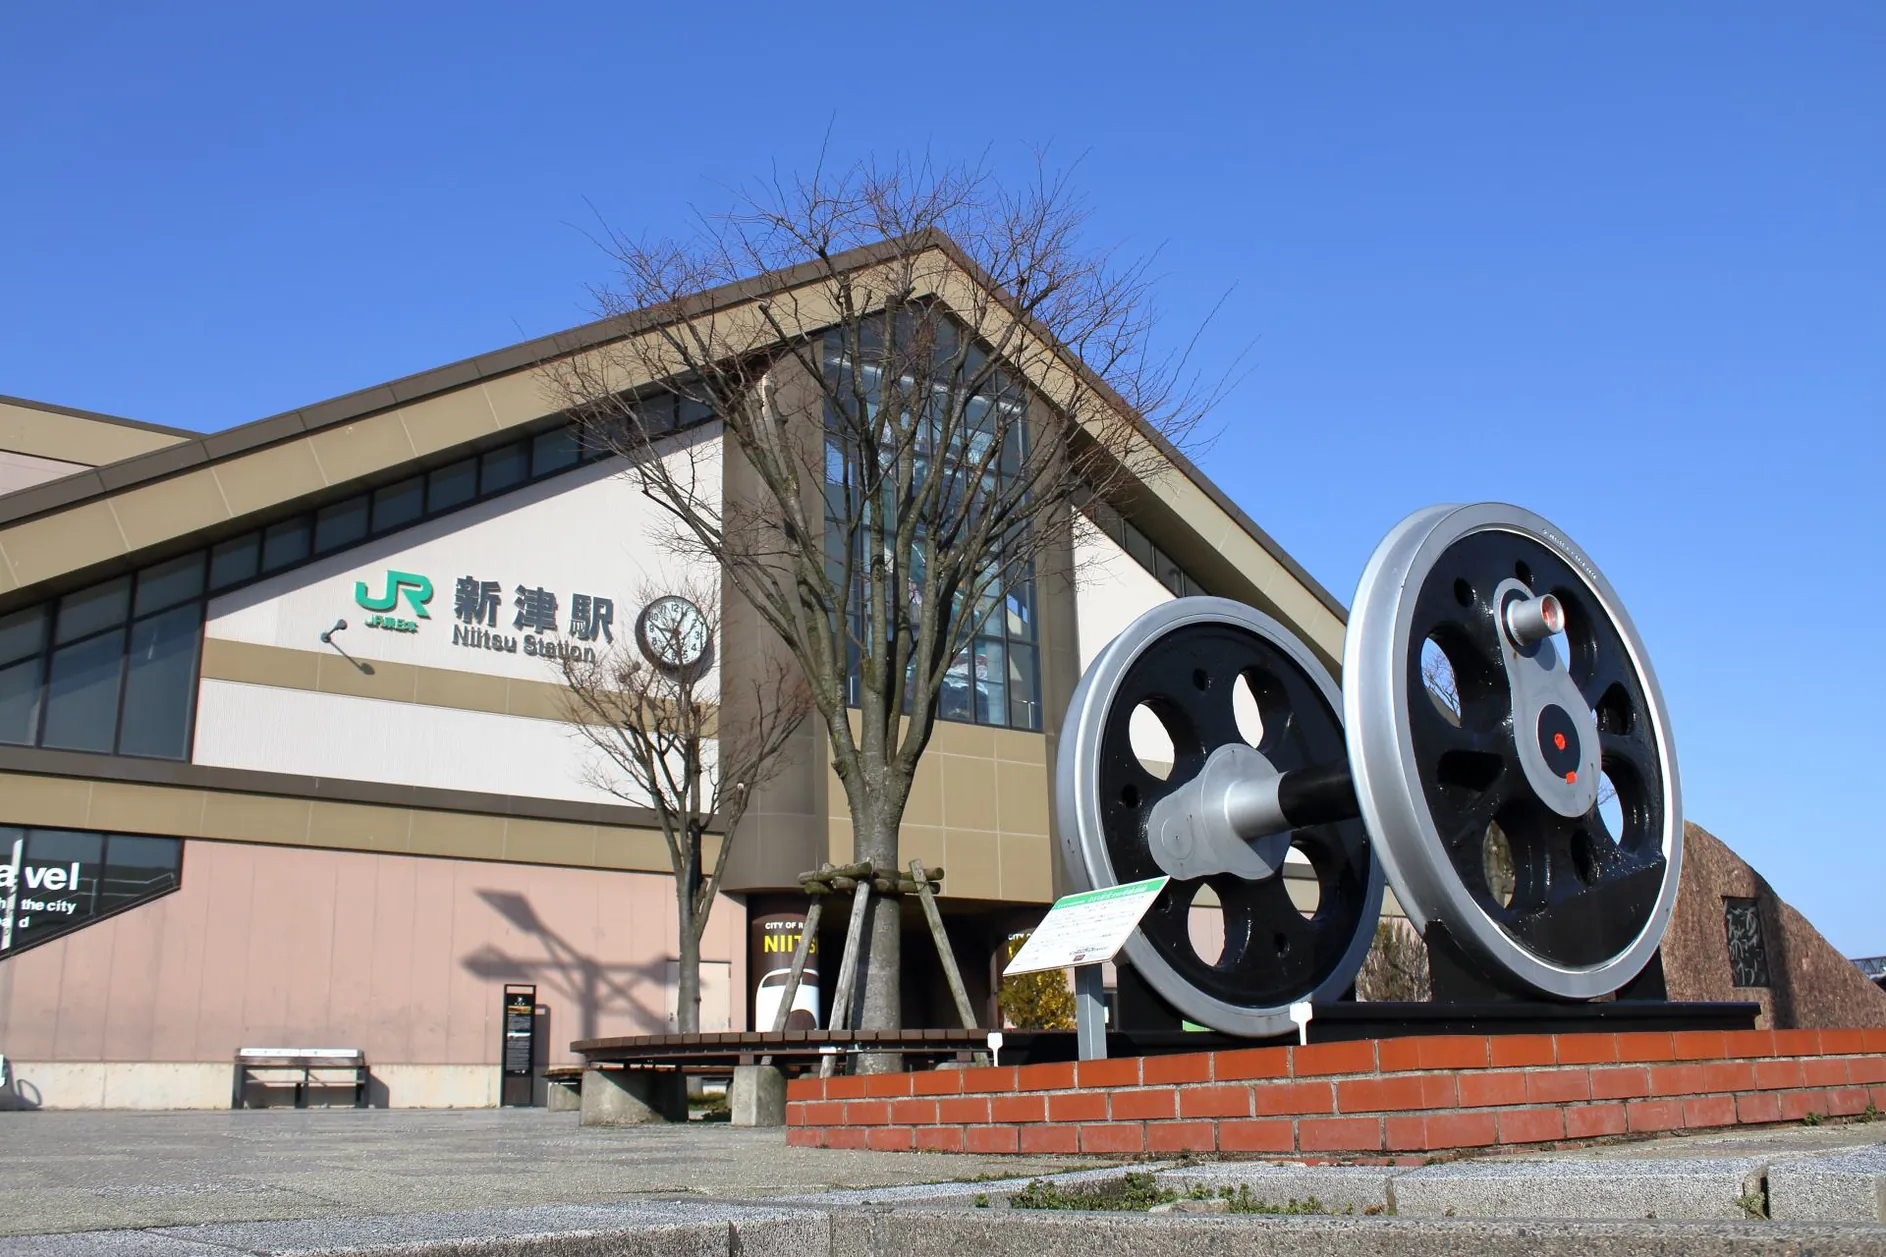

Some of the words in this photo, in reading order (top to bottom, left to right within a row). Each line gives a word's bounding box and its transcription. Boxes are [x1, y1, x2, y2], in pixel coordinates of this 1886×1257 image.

[355, 570, 433, 618] JR
[454, 575, 614, 643] 新津駅
[452, 624, 517, 653] Niitsu
[523, 633, 596, 664] Station
[694, 631, 700, 640] 3
[21, 898, 44, 911] the
[46, 899, 77, 915] city
[765, 922, 783, 930] CITY
